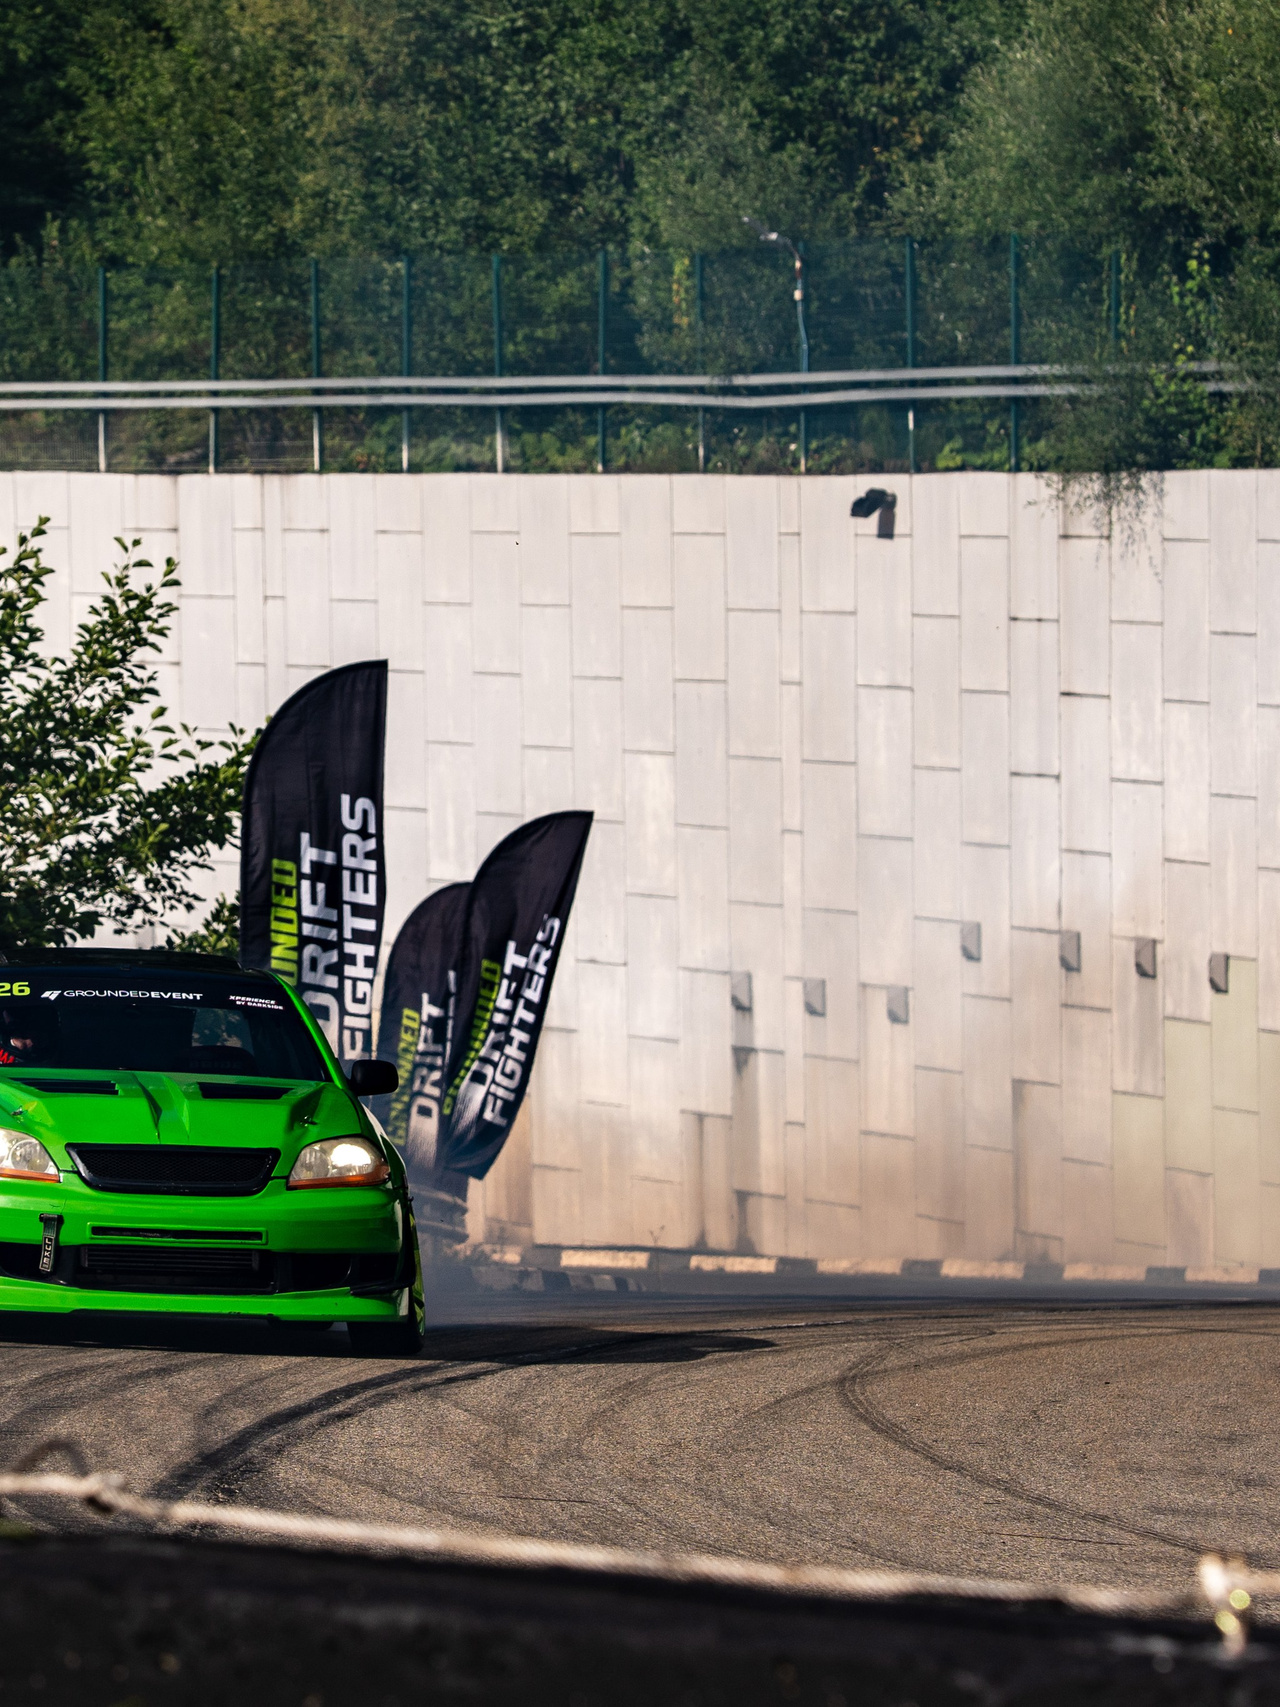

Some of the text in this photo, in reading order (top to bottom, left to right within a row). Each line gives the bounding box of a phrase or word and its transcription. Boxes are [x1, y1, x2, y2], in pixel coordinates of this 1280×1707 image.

[270, 857, 298, 987] UNDED
[340, 793, 377, 1061] FIGHTERS
[229, 995, 276, 1004] XPERIENCE
[247, 1002, 284, 1010] DARKSIDE
[482, 913, 561, 1127] FIGHTERS
[406, 992, 444, 1168] DRIFT
